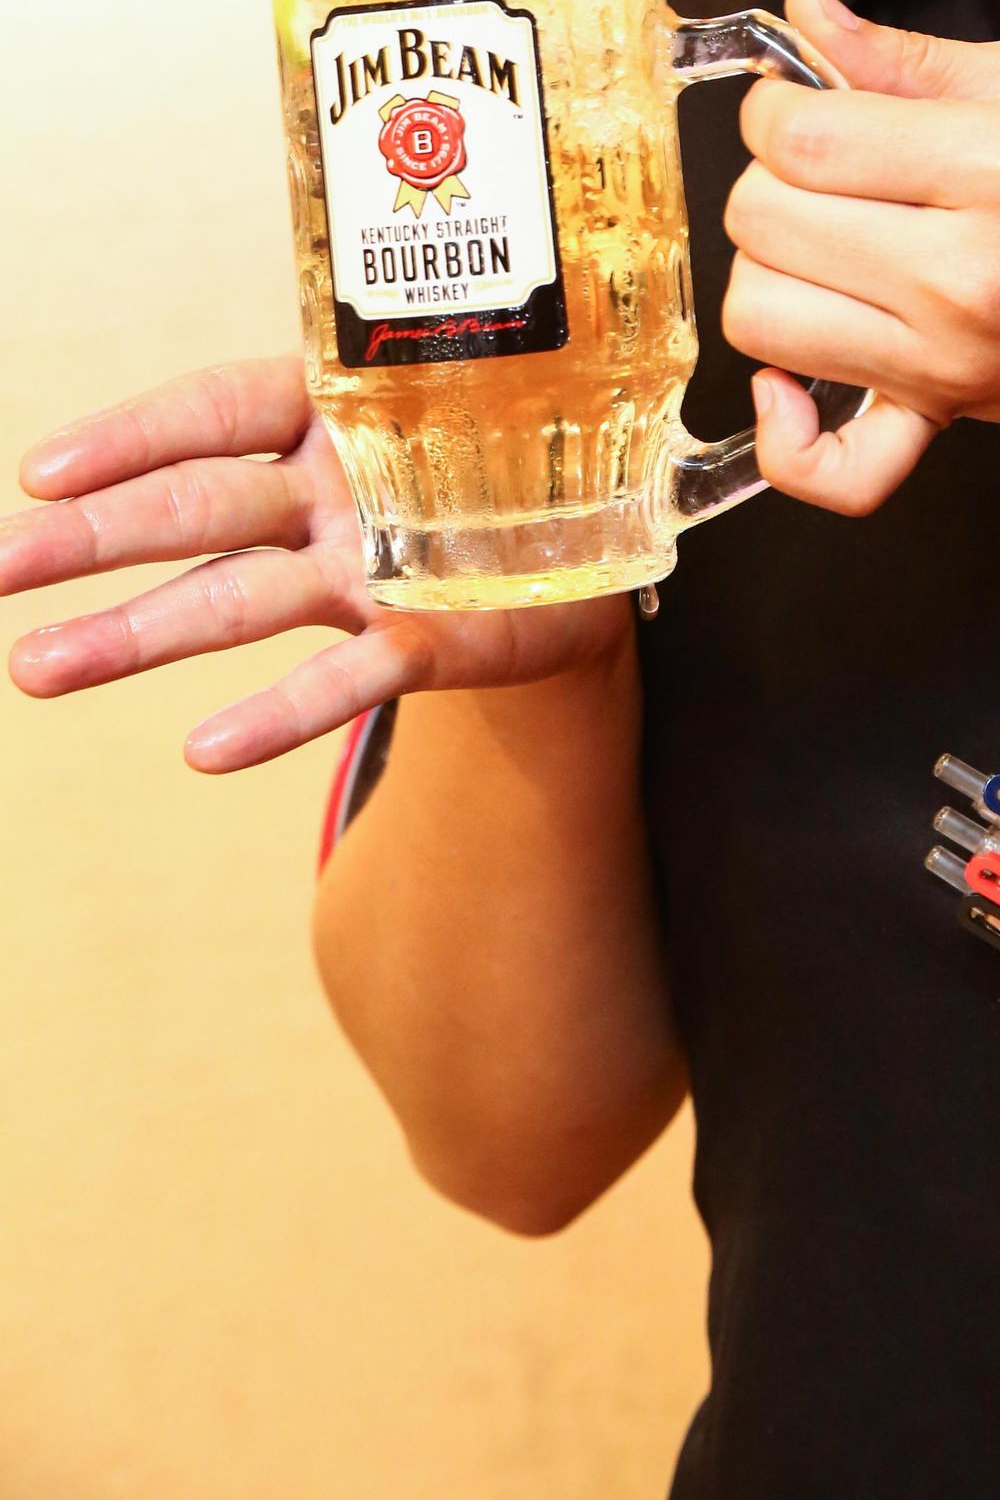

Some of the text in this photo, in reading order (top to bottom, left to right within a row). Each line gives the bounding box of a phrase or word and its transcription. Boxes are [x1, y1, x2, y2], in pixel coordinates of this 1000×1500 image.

[329, 28, 520, 125] JIM BEAM
[397, 112, 448, 137] JIM BEAM
[412, 130, 433, 154] B
[361, 215, 508, 245] KENTUCKY STRAIGHT
[363, 236, 511, 286] BOURBON
[405, 283, 470, 304] WHISKEY
